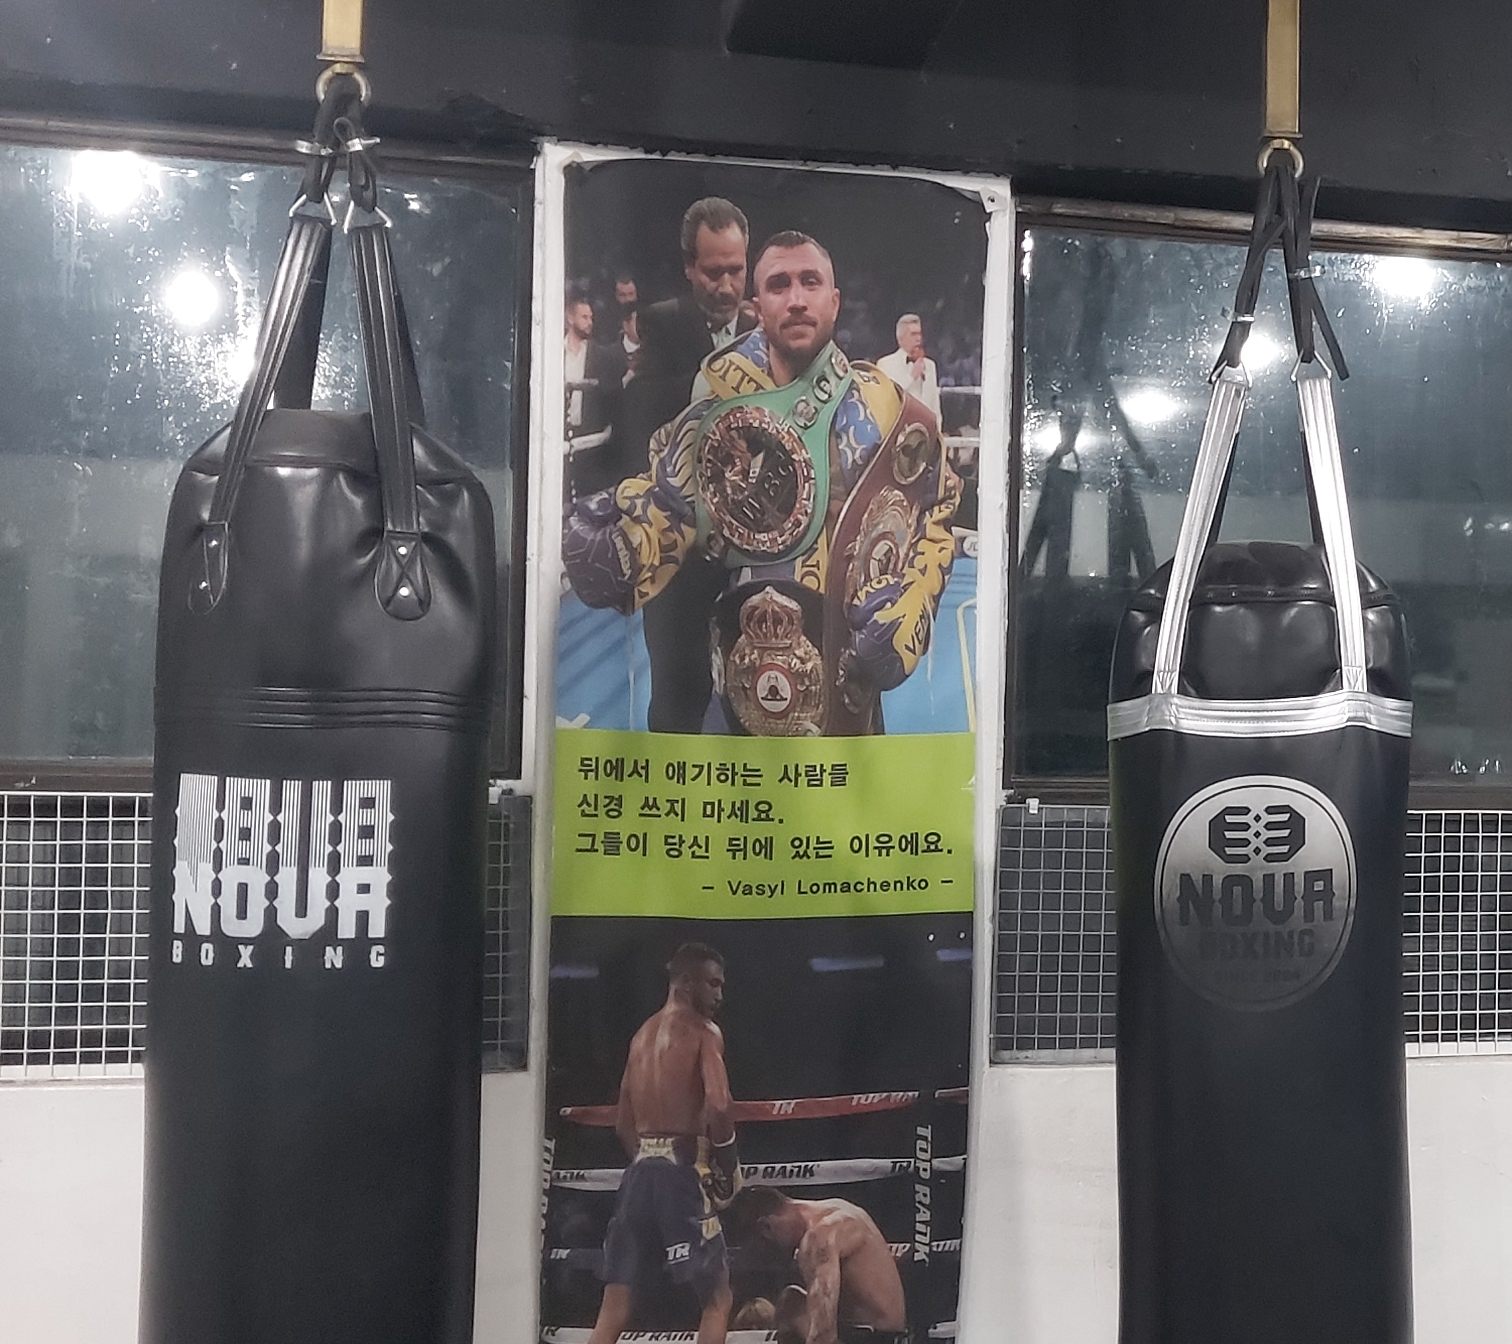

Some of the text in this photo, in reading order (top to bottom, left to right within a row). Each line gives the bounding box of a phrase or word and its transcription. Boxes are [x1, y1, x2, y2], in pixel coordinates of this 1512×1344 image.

[577, 756, 849, 788] 뒤에서 얘기하는 사람들
[577, 793, 785, 824] 신경 쓰지 마세요.
[574, 831, 953, 861] 그들이 당신 뒤에 있는 이유에요.
[727, 879, 785, 899] Vasyl
[797, 876, 929, 896] Lomachenko
[1176, 868, 1336, 927] NOVA
[171, 940, 386, 969] BOXING
[914, 1124, 932, 1266] TOP RANK
